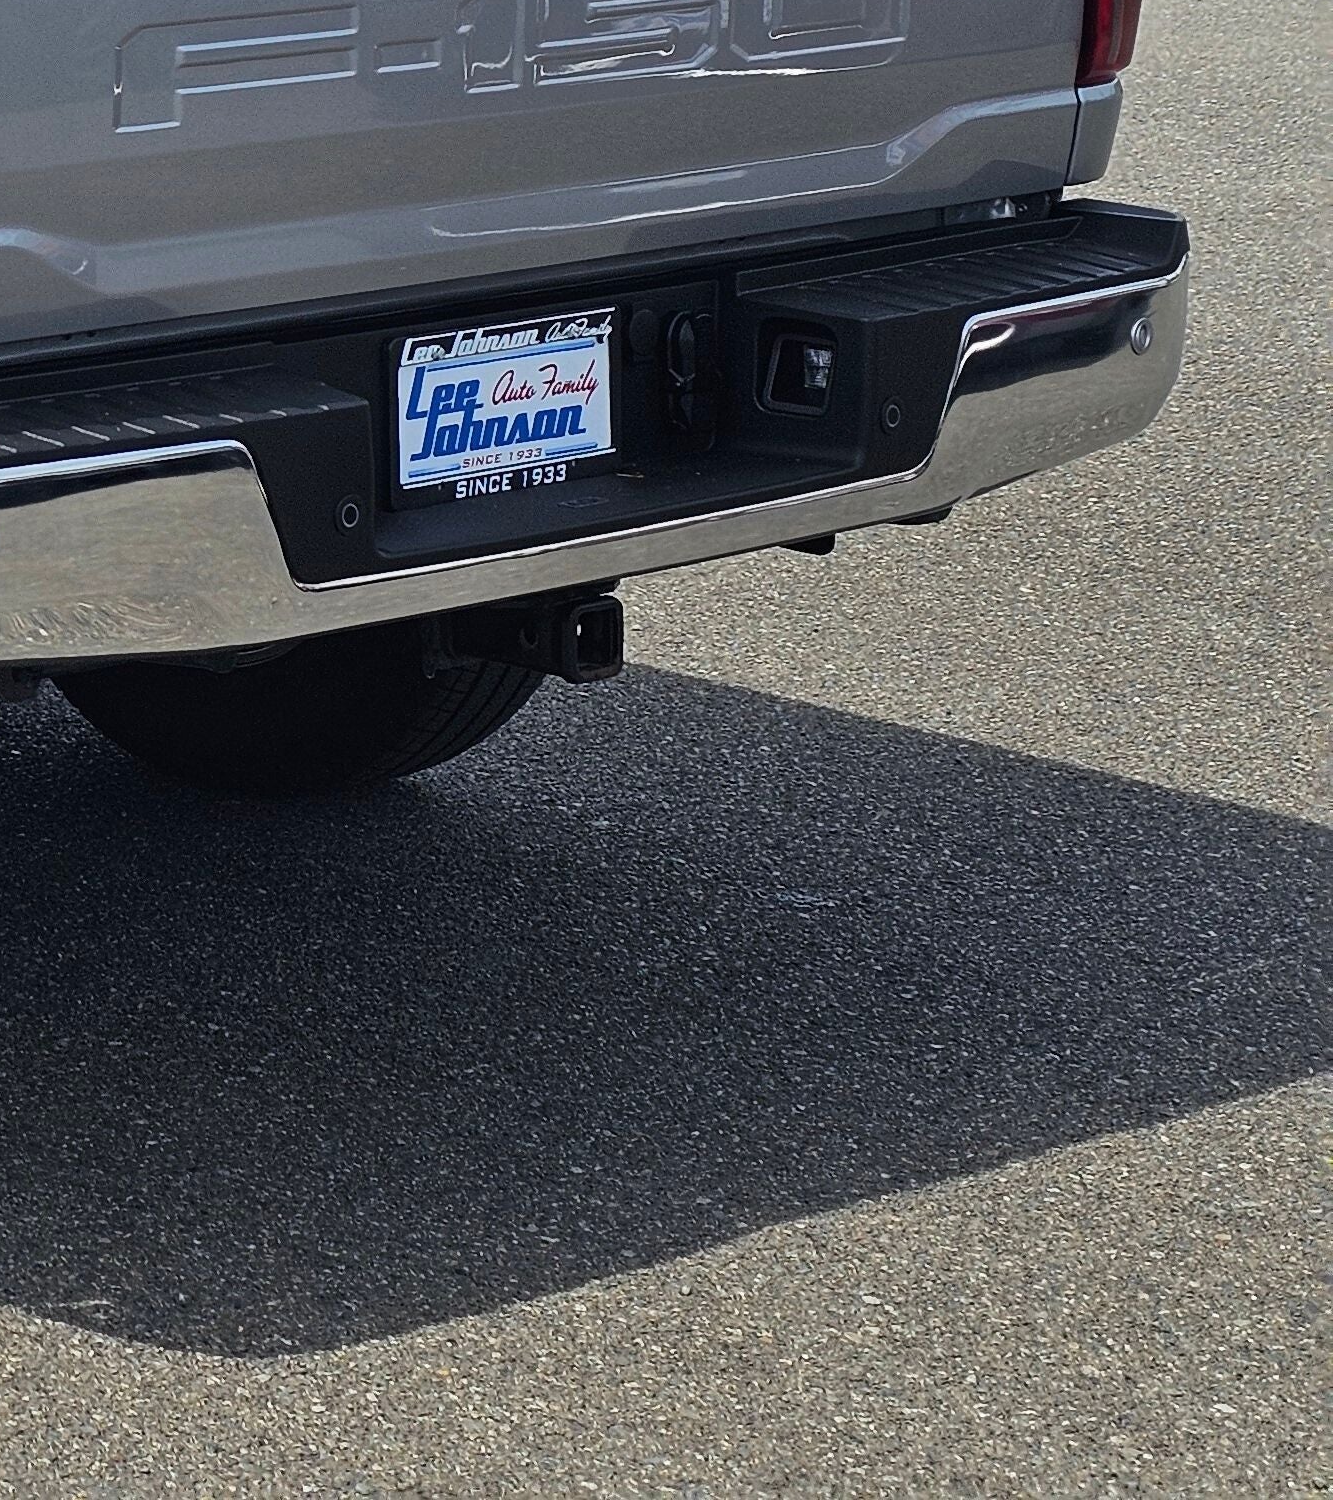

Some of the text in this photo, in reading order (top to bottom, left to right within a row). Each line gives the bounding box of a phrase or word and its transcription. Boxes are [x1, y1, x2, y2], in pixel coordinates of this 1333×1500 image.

[400, 338, 446, 366] Lee
[446, 327, 540, 358] Johnson
[405, 358, 599, 420] Lee Auto Family
[409, 401, 587, 462] Johnson
[462, 447, 543, 468] SINCE 1933
[455, 463, 567, 499] SINCE 1933
